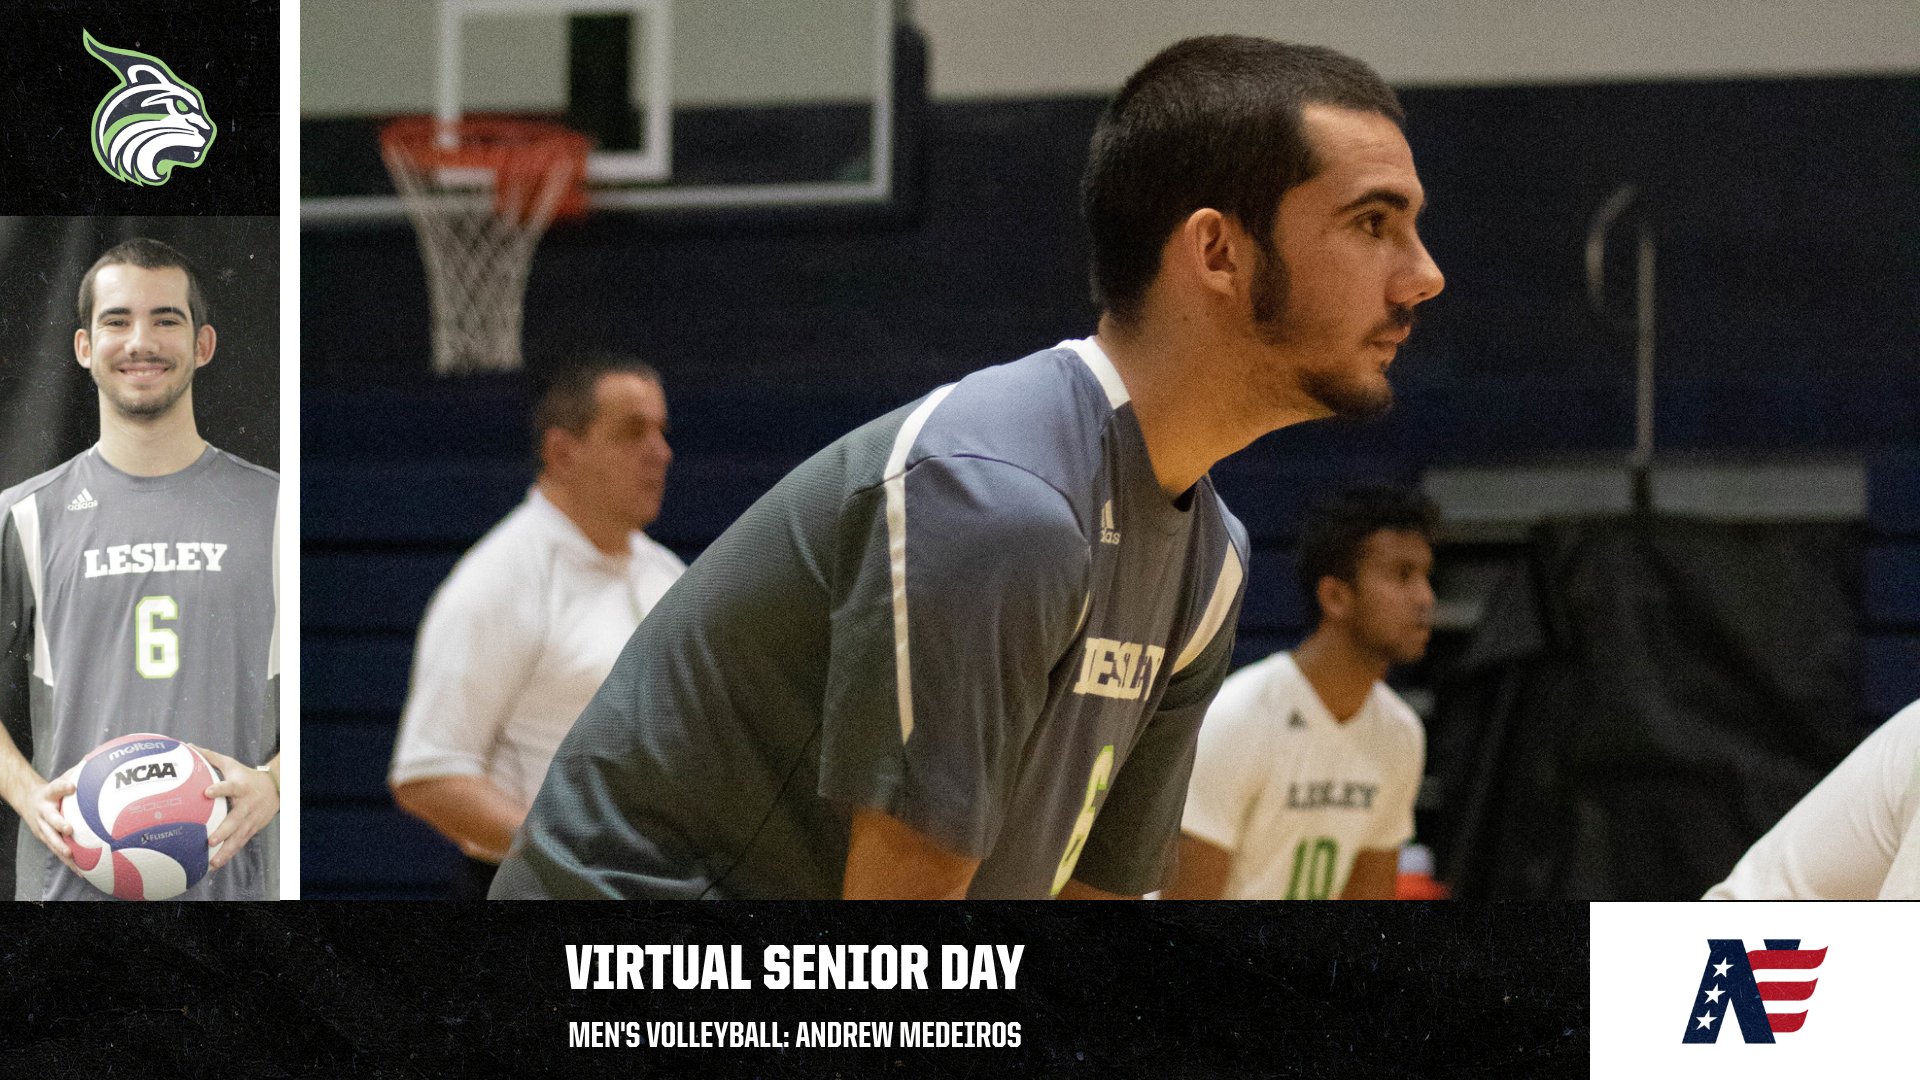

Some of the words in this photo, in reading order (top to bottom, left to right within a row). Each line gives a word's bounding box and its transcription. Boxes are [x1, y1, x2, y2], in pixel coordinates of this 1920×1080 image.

[67, 500, 98, 511] adidas
[83, 542, 228, 578] LESLEY
[135, 595, 180, 680] 6
[108, 741, 166, 761] molten
[114, 762, 177, 789] NCAA
[1287, 781, 1378, 810] LESLEY
